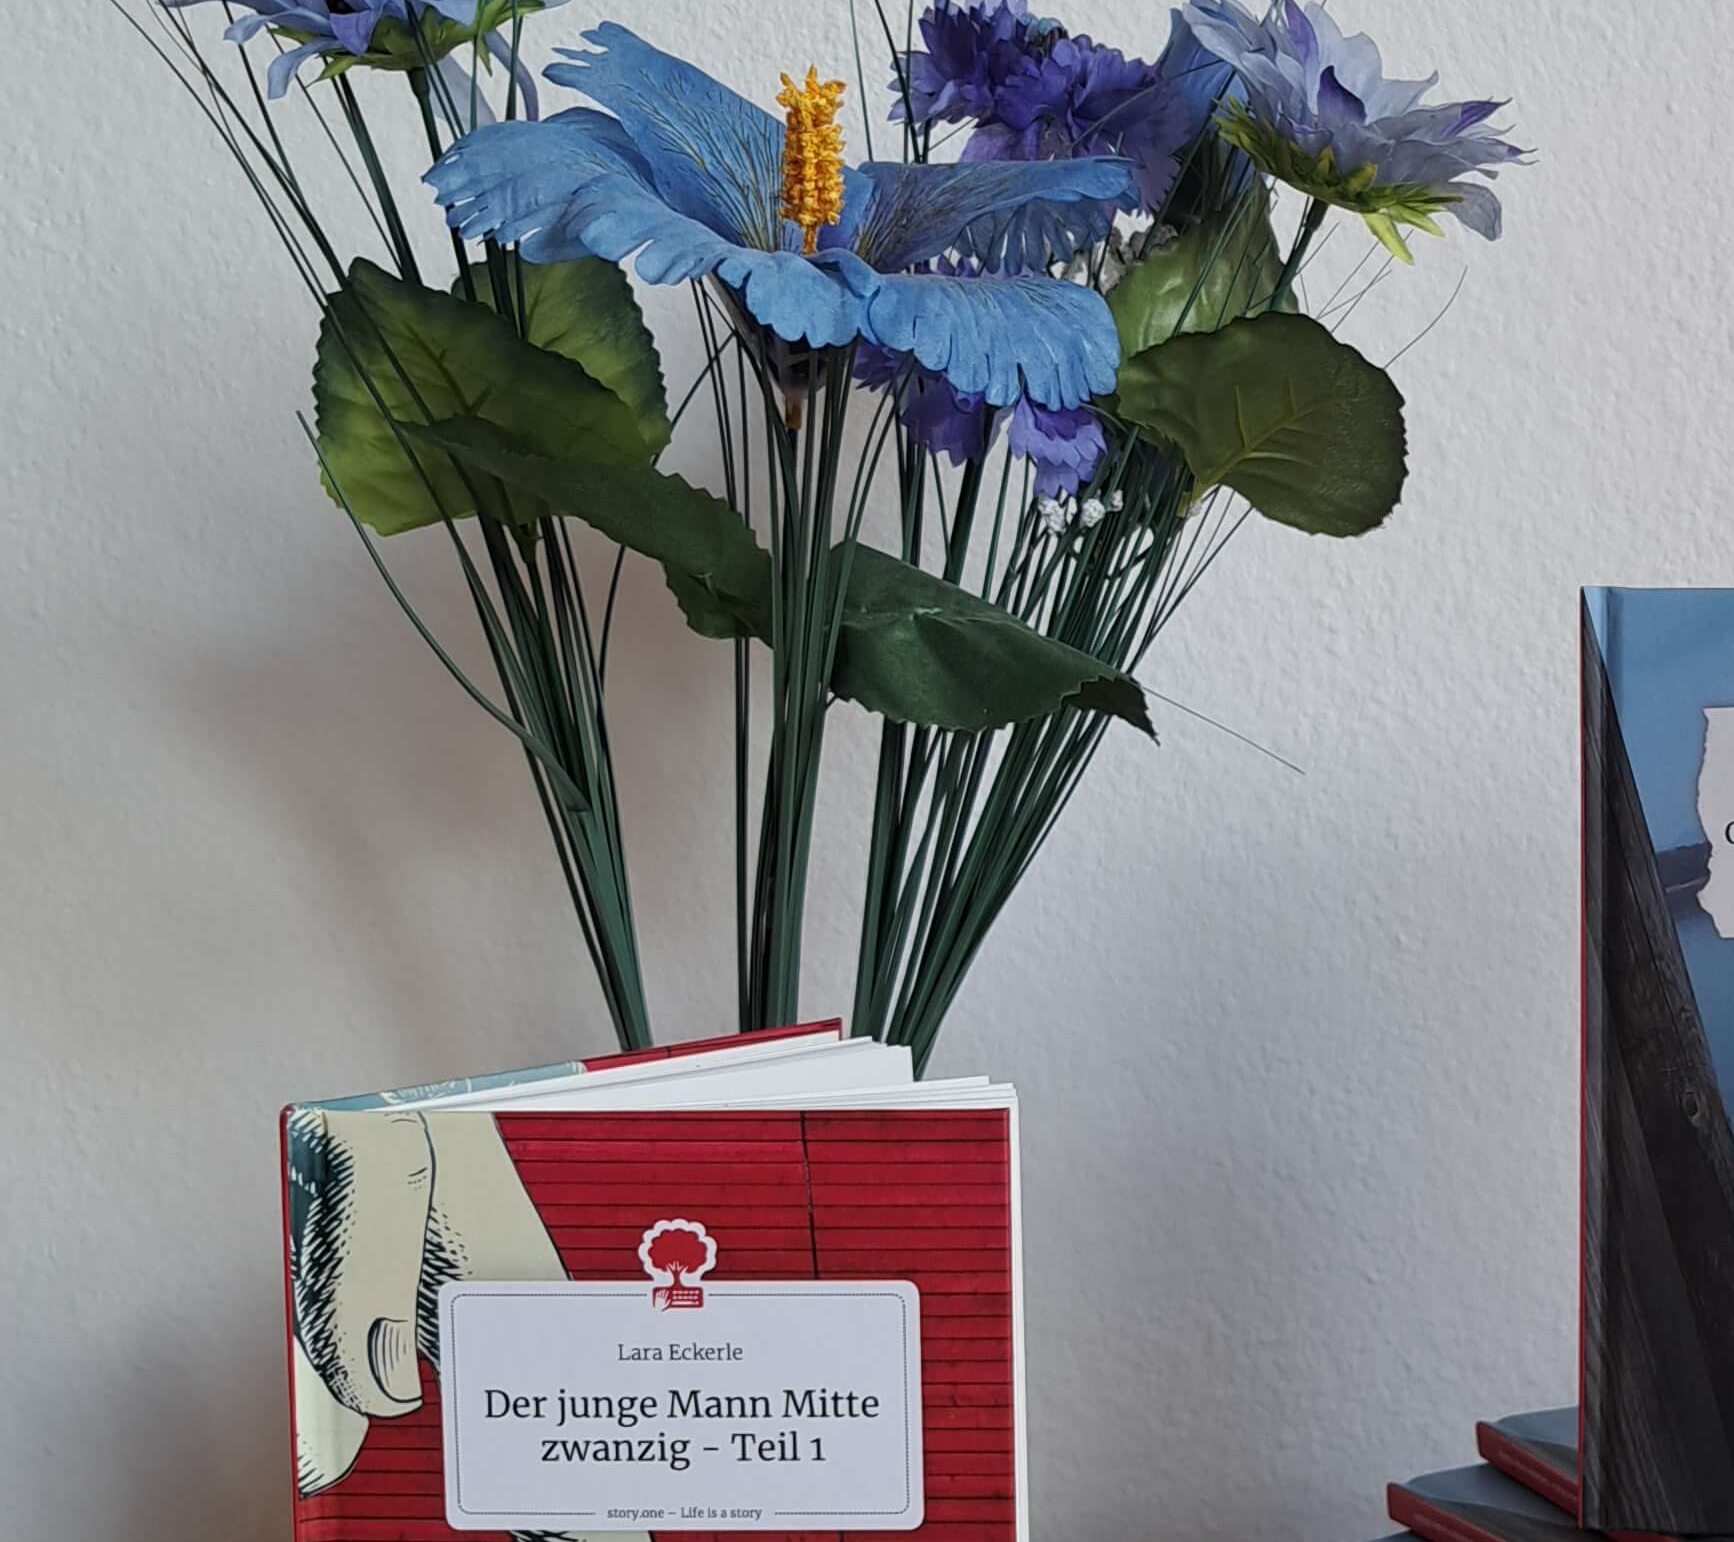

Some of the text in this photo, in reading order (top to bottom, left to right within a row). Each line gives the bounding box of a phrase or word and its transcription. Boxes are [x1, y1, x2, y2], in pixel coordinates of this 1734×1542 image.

[617, 1342, 743, 1361] Lara Eckerle
[484, 1387, 881, 1428] Der junge Mann Mitte
[541, 1432, 691, 1471] zwanzig
[730, 1430, 800, 1462] Teil
[810, 1436, 826, 1462] 1
[607, 1505, 665, 1521] story.one
[681, 1505, 704, 1520] Life
[707, 1506, 718, 1520] is
[720, 1509, 728, 1520] a
[730, 1507, 763, 1522] story
